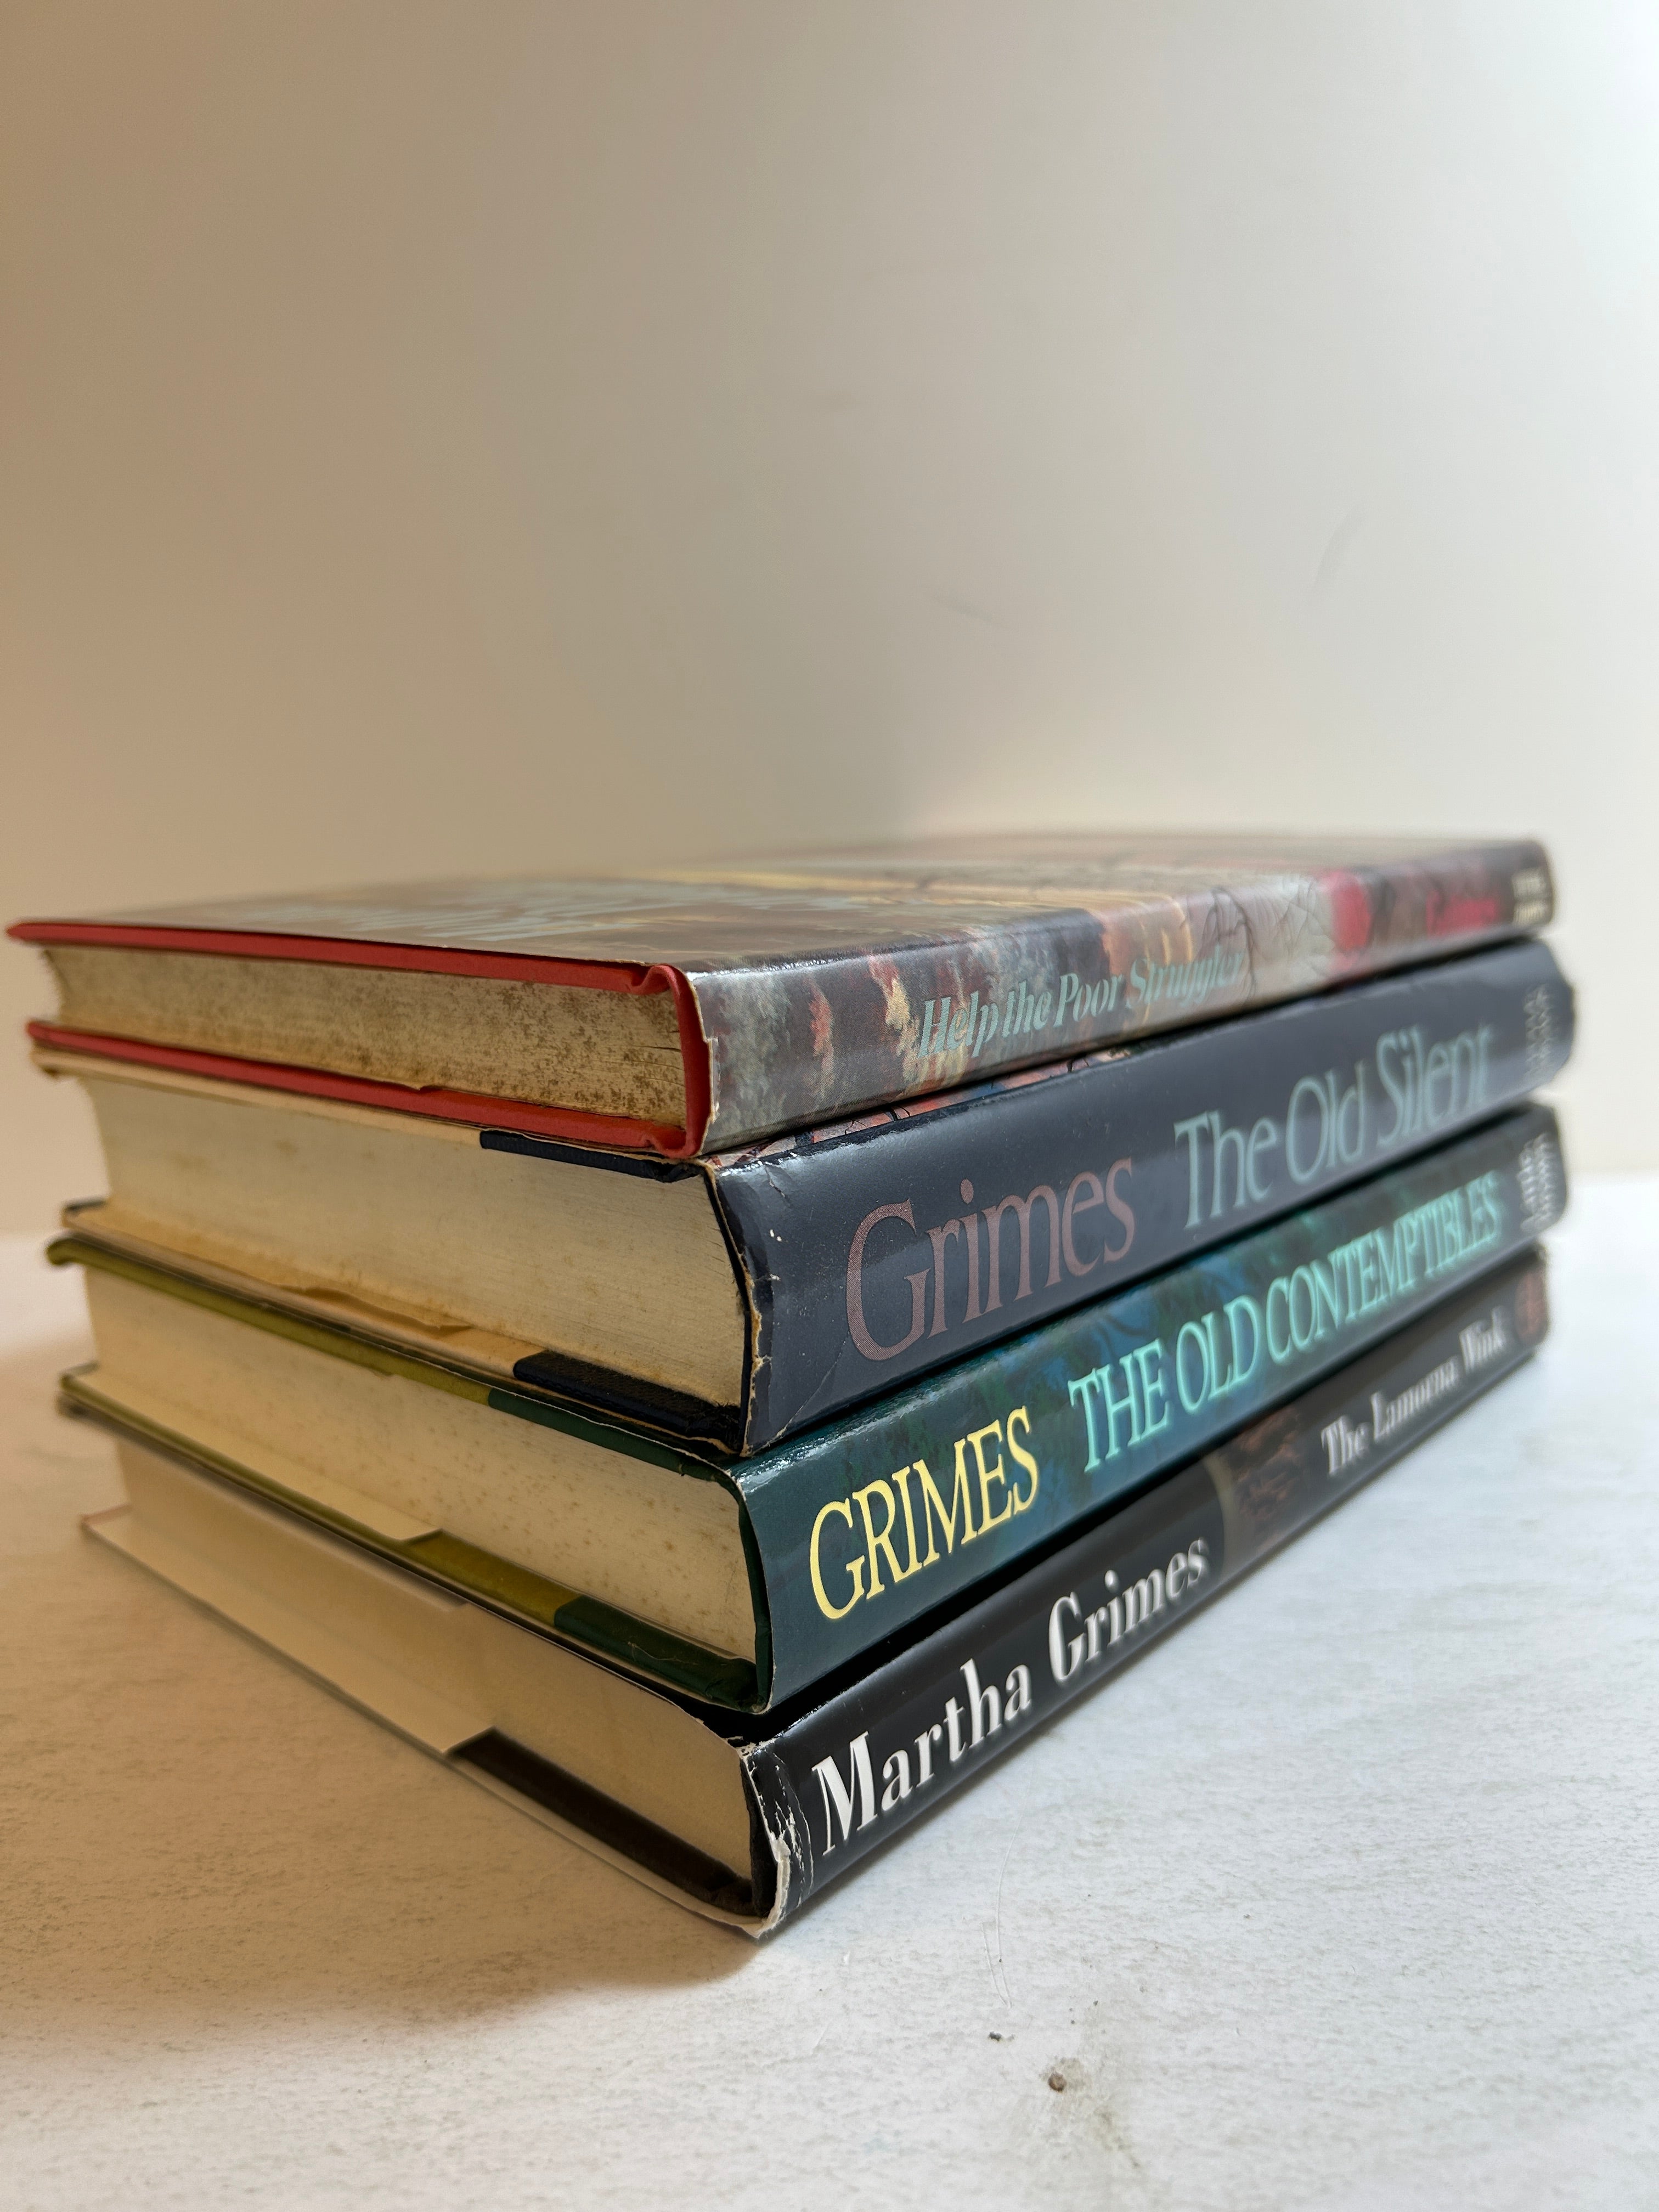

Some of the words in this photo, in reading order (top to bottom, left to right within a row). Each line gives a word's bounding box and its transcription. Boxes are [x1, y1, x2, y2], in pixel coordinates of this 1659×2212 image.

[845, 1157, 1136, 1361] Grimes
[1173, 1109, 1278, 1230] The
[1285, 1059, 1369, 1185] Old
[1376, 1024, 1494, 1147] Silent
[917, 992, 1001, 1058] Help
[1001, 980, 1054, 1038] the
[1053, 972, 1125, 1028] Poor
[809, 1405, 1039, 1619] GRIMES
[1067, 1338, 1170, 1474] THE
[1176, 1295, 1260, 1414] OLD
[1266, 1169, 1503, 1366] CONTEMPTIBLES
[811, 1658, 1032, 1857] Martha
[1048, 1537, 1209, 1683] Grimes
[1321, 1415, 1368, 1475] The
